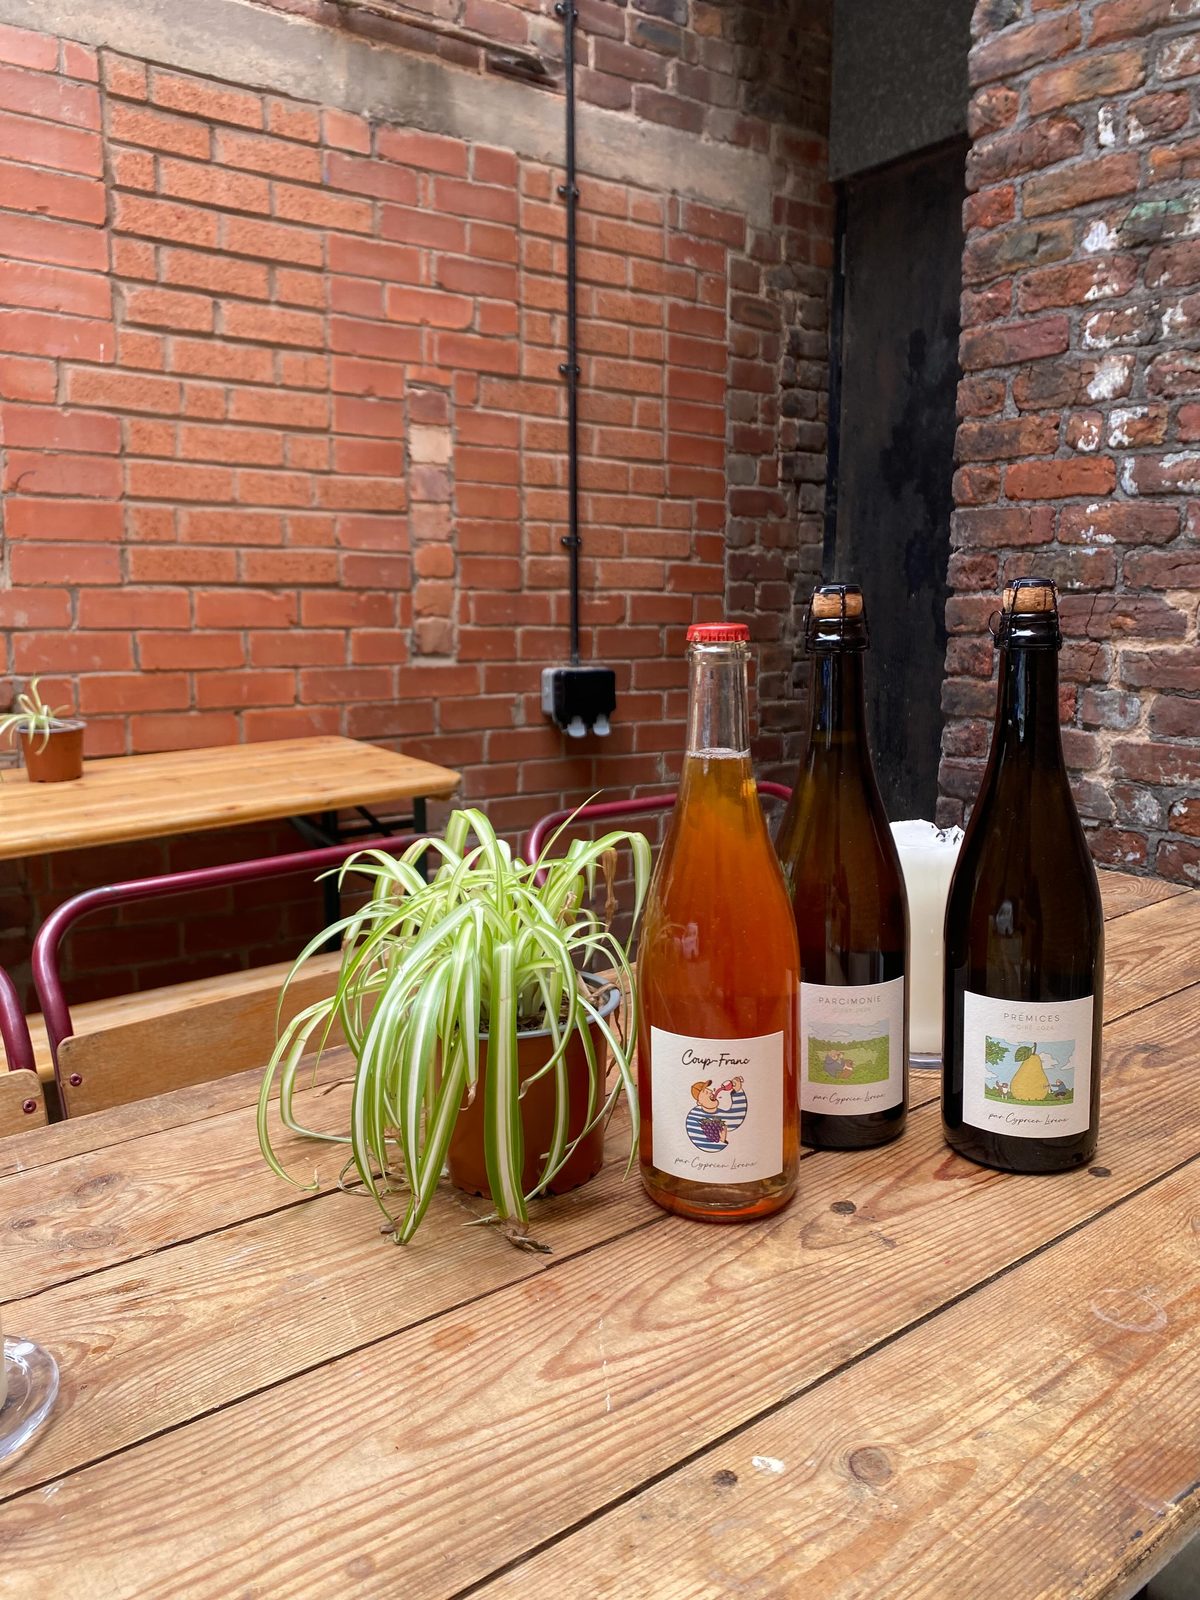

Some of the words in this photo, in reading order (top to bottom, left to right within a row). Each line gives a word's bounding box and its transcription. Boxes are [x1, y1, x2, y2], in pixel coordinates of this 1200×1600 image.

[818, 995, 881, 1006] PARCIMONIE
[1003, 1010, 1060, 1023] PRÉMICES
[681, 1048, 751, 1071] Coup-Franc
